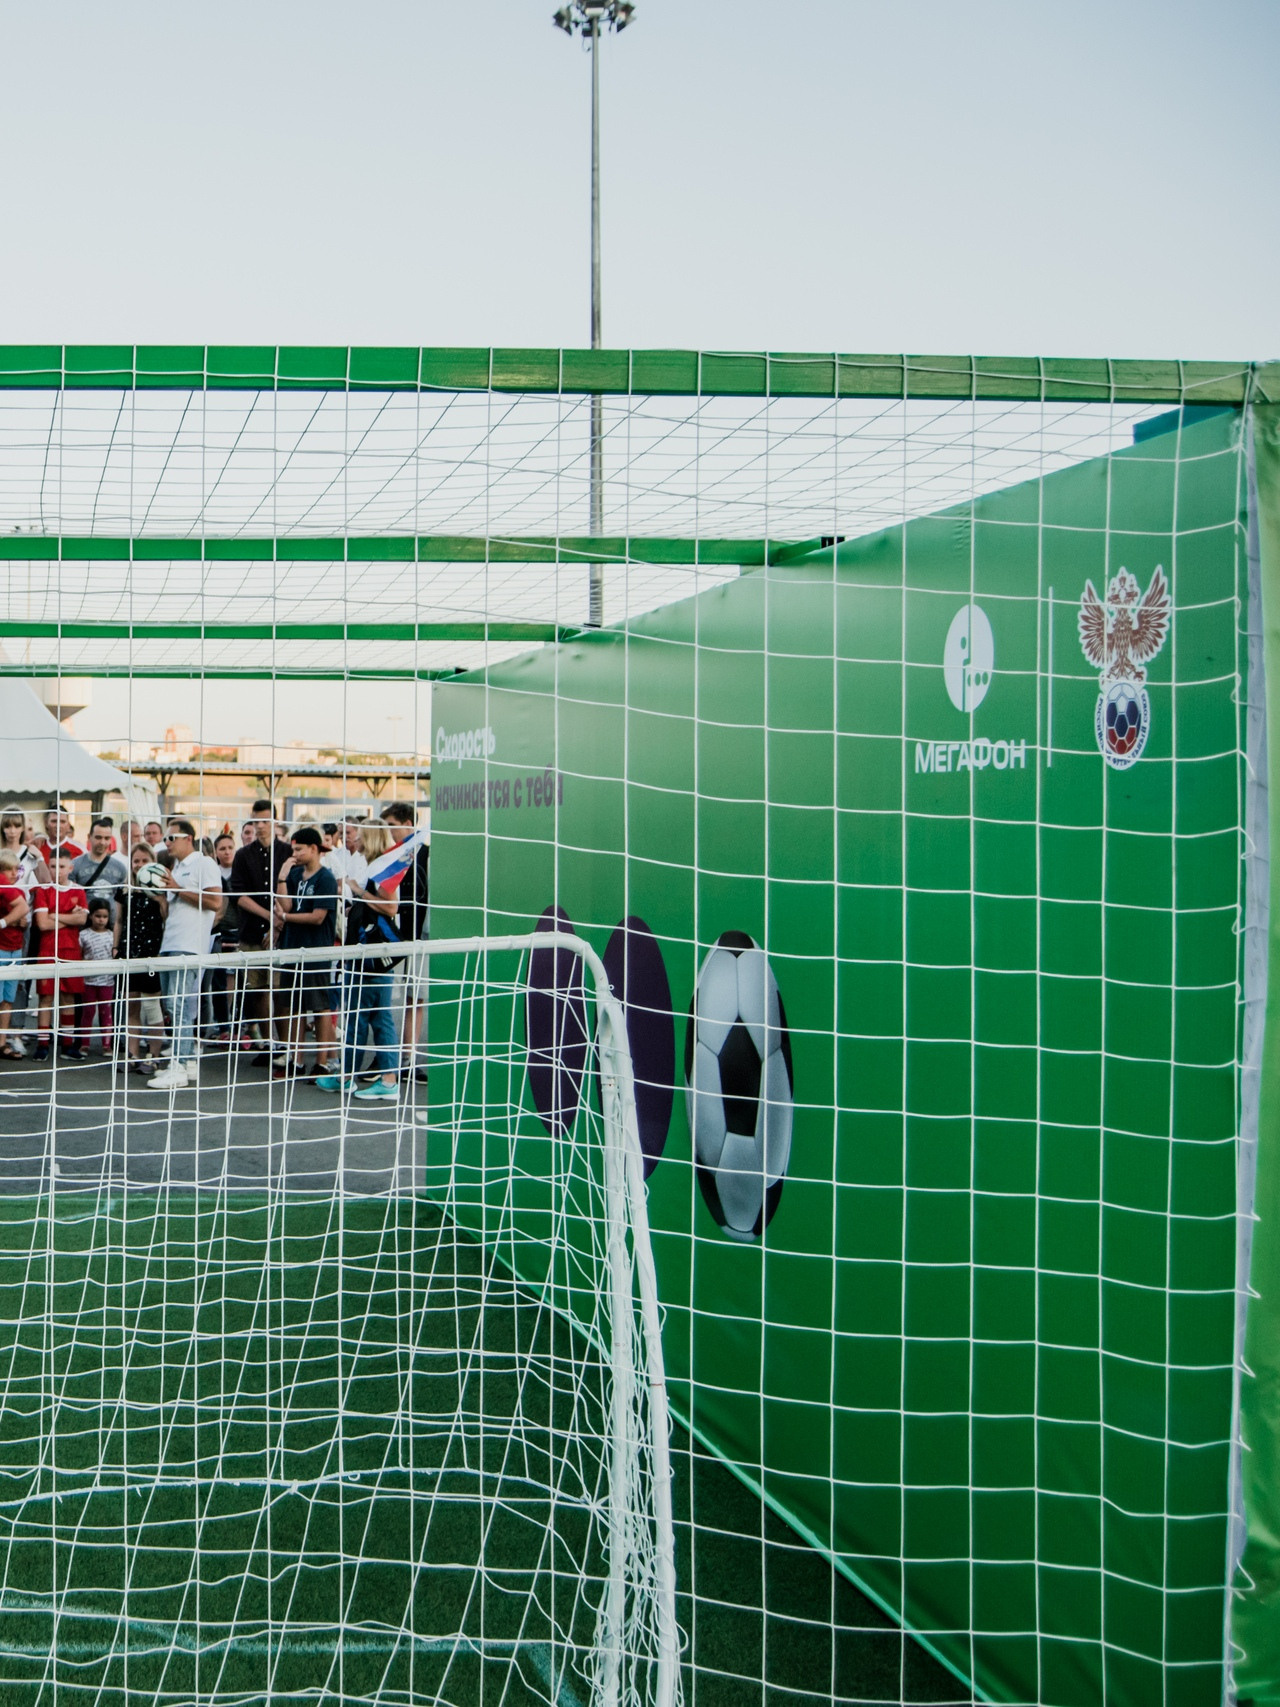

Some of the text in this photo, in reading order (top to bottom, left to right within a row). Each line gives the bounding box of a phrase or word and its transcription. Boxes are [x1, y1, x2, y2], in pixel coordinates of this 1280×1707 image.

[436, 726, 496, 769] Скорость
[915, 738, 1025, 773] МЕГАФОН
[436, 763, 563, 811] начинается с тебя
